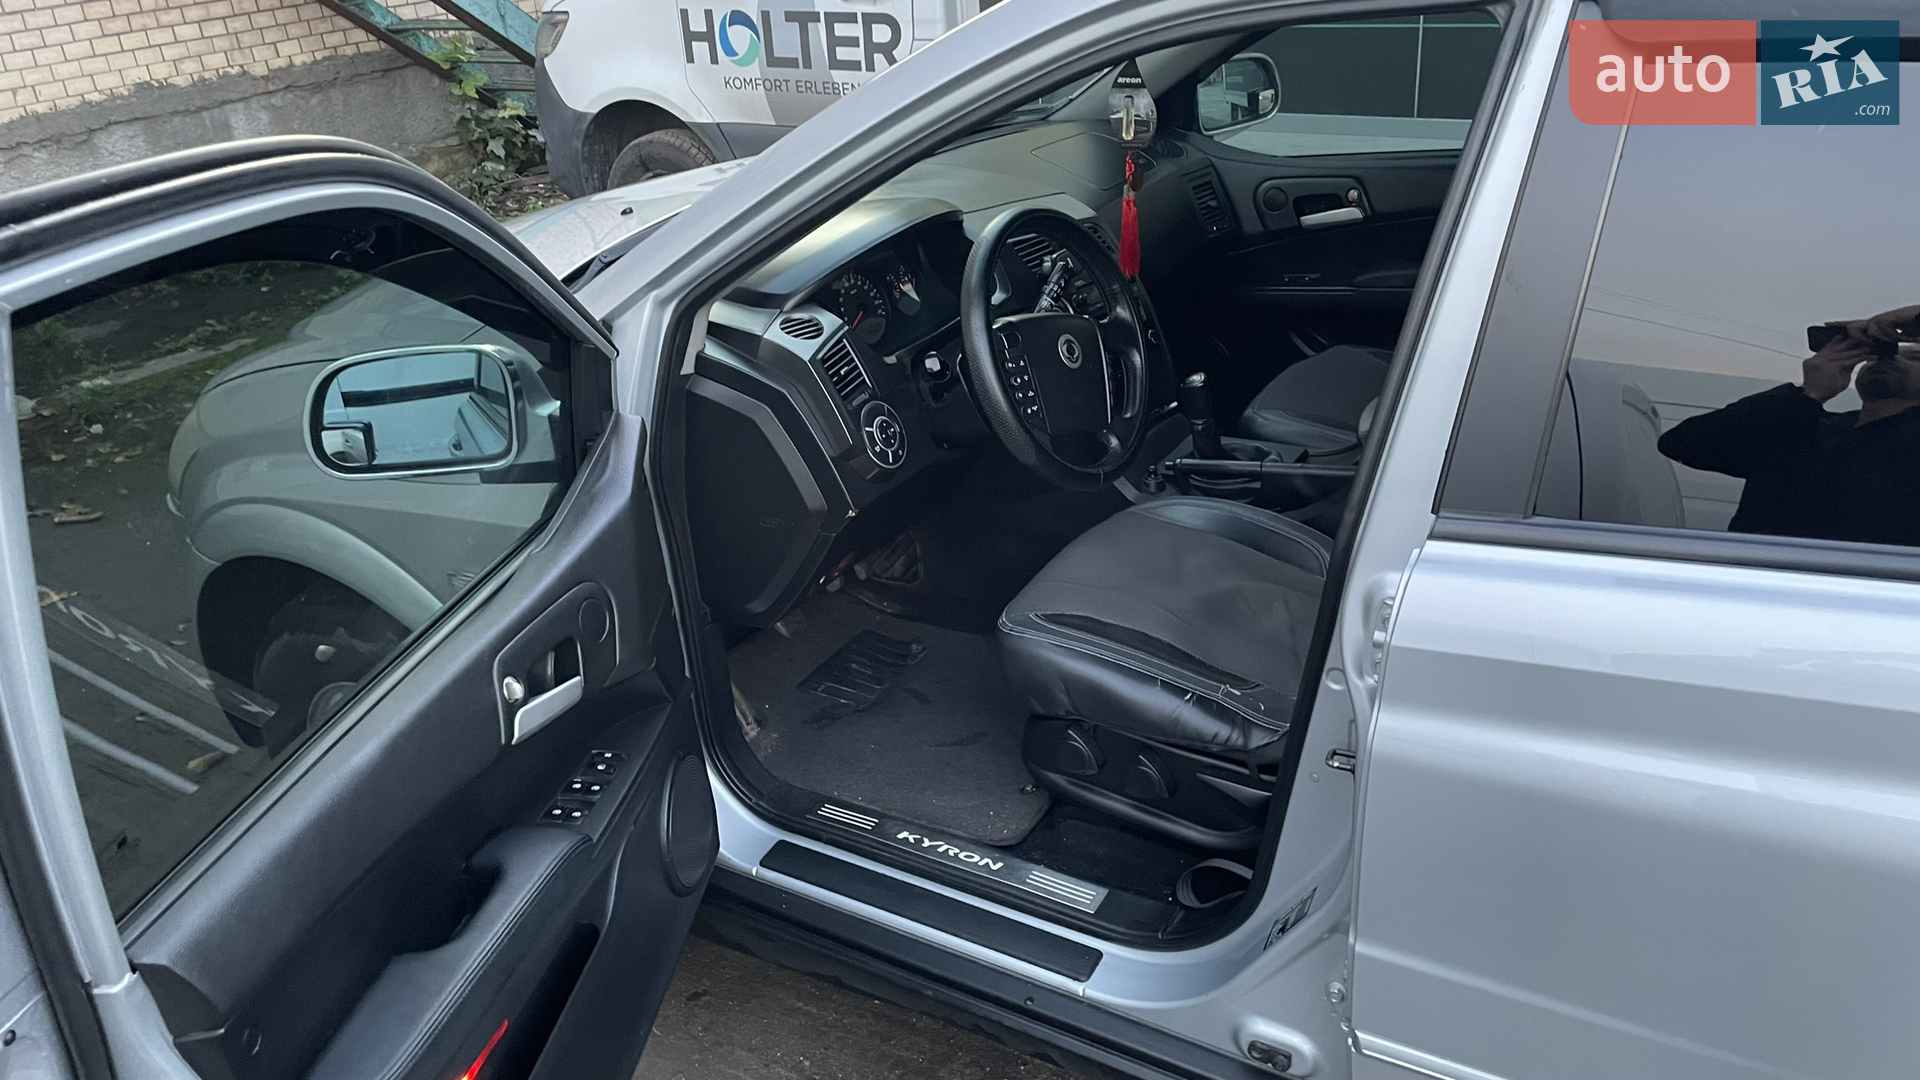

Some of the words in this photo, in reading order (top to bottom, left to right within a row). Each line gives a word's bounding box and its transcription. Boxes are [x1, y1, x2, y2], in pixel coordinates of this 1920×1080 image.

[680, 8, 902, 72] HOLTER
[724, 76, 791, 93] KOMFORT
[896, 831, 1005, 871] KYRON
